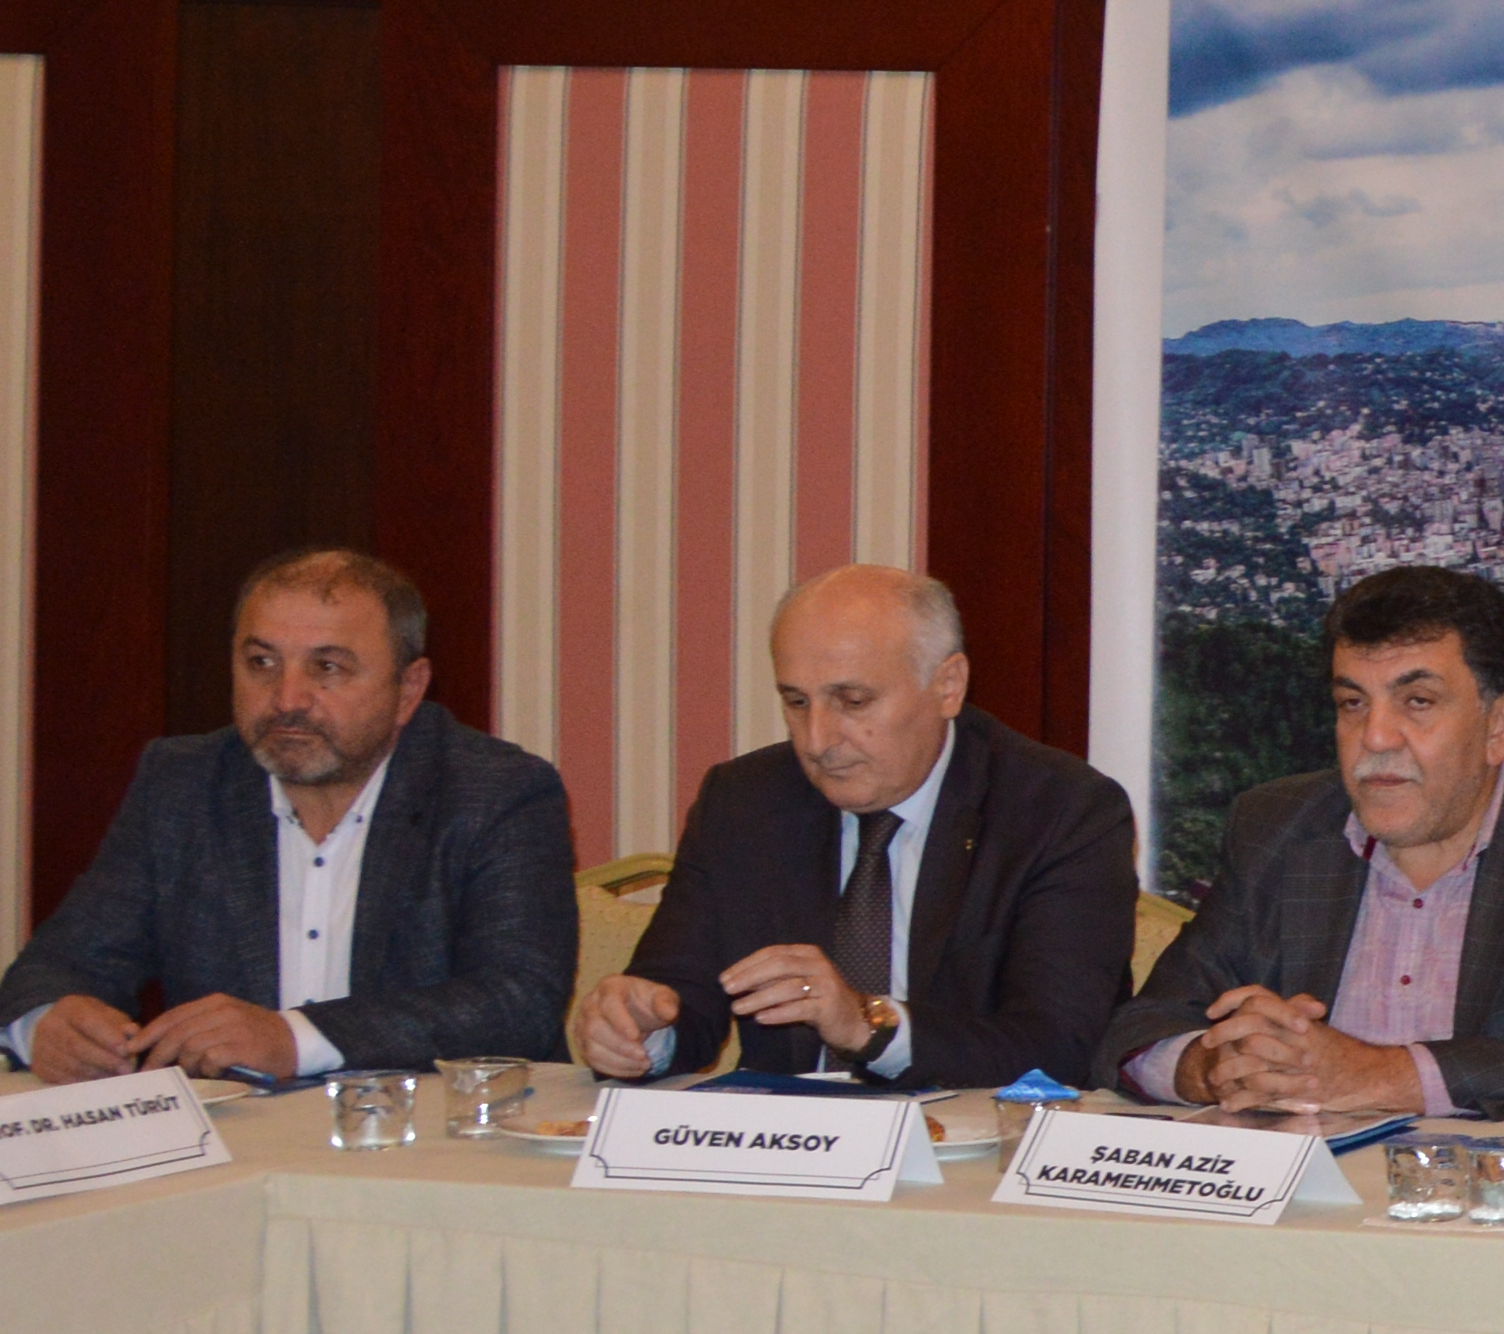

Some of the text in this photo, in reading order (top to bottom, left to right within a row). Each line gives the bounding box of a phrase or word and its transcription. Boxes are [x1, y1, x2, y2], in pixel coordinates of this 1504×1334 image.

[29, 1116, 60, 1135] DR.
[59, 1105, 124, 1130] HASAN
[124, 1094, 181, 1118] TÜRÜT
[653, 1124, 840, 1153] GÜVEN AKSOY
[1090, 1145, 1236, 1175] ŞABAN AZİZ
[1036, 1164, 1265, 1202] KARAMEHMETOĞLU
